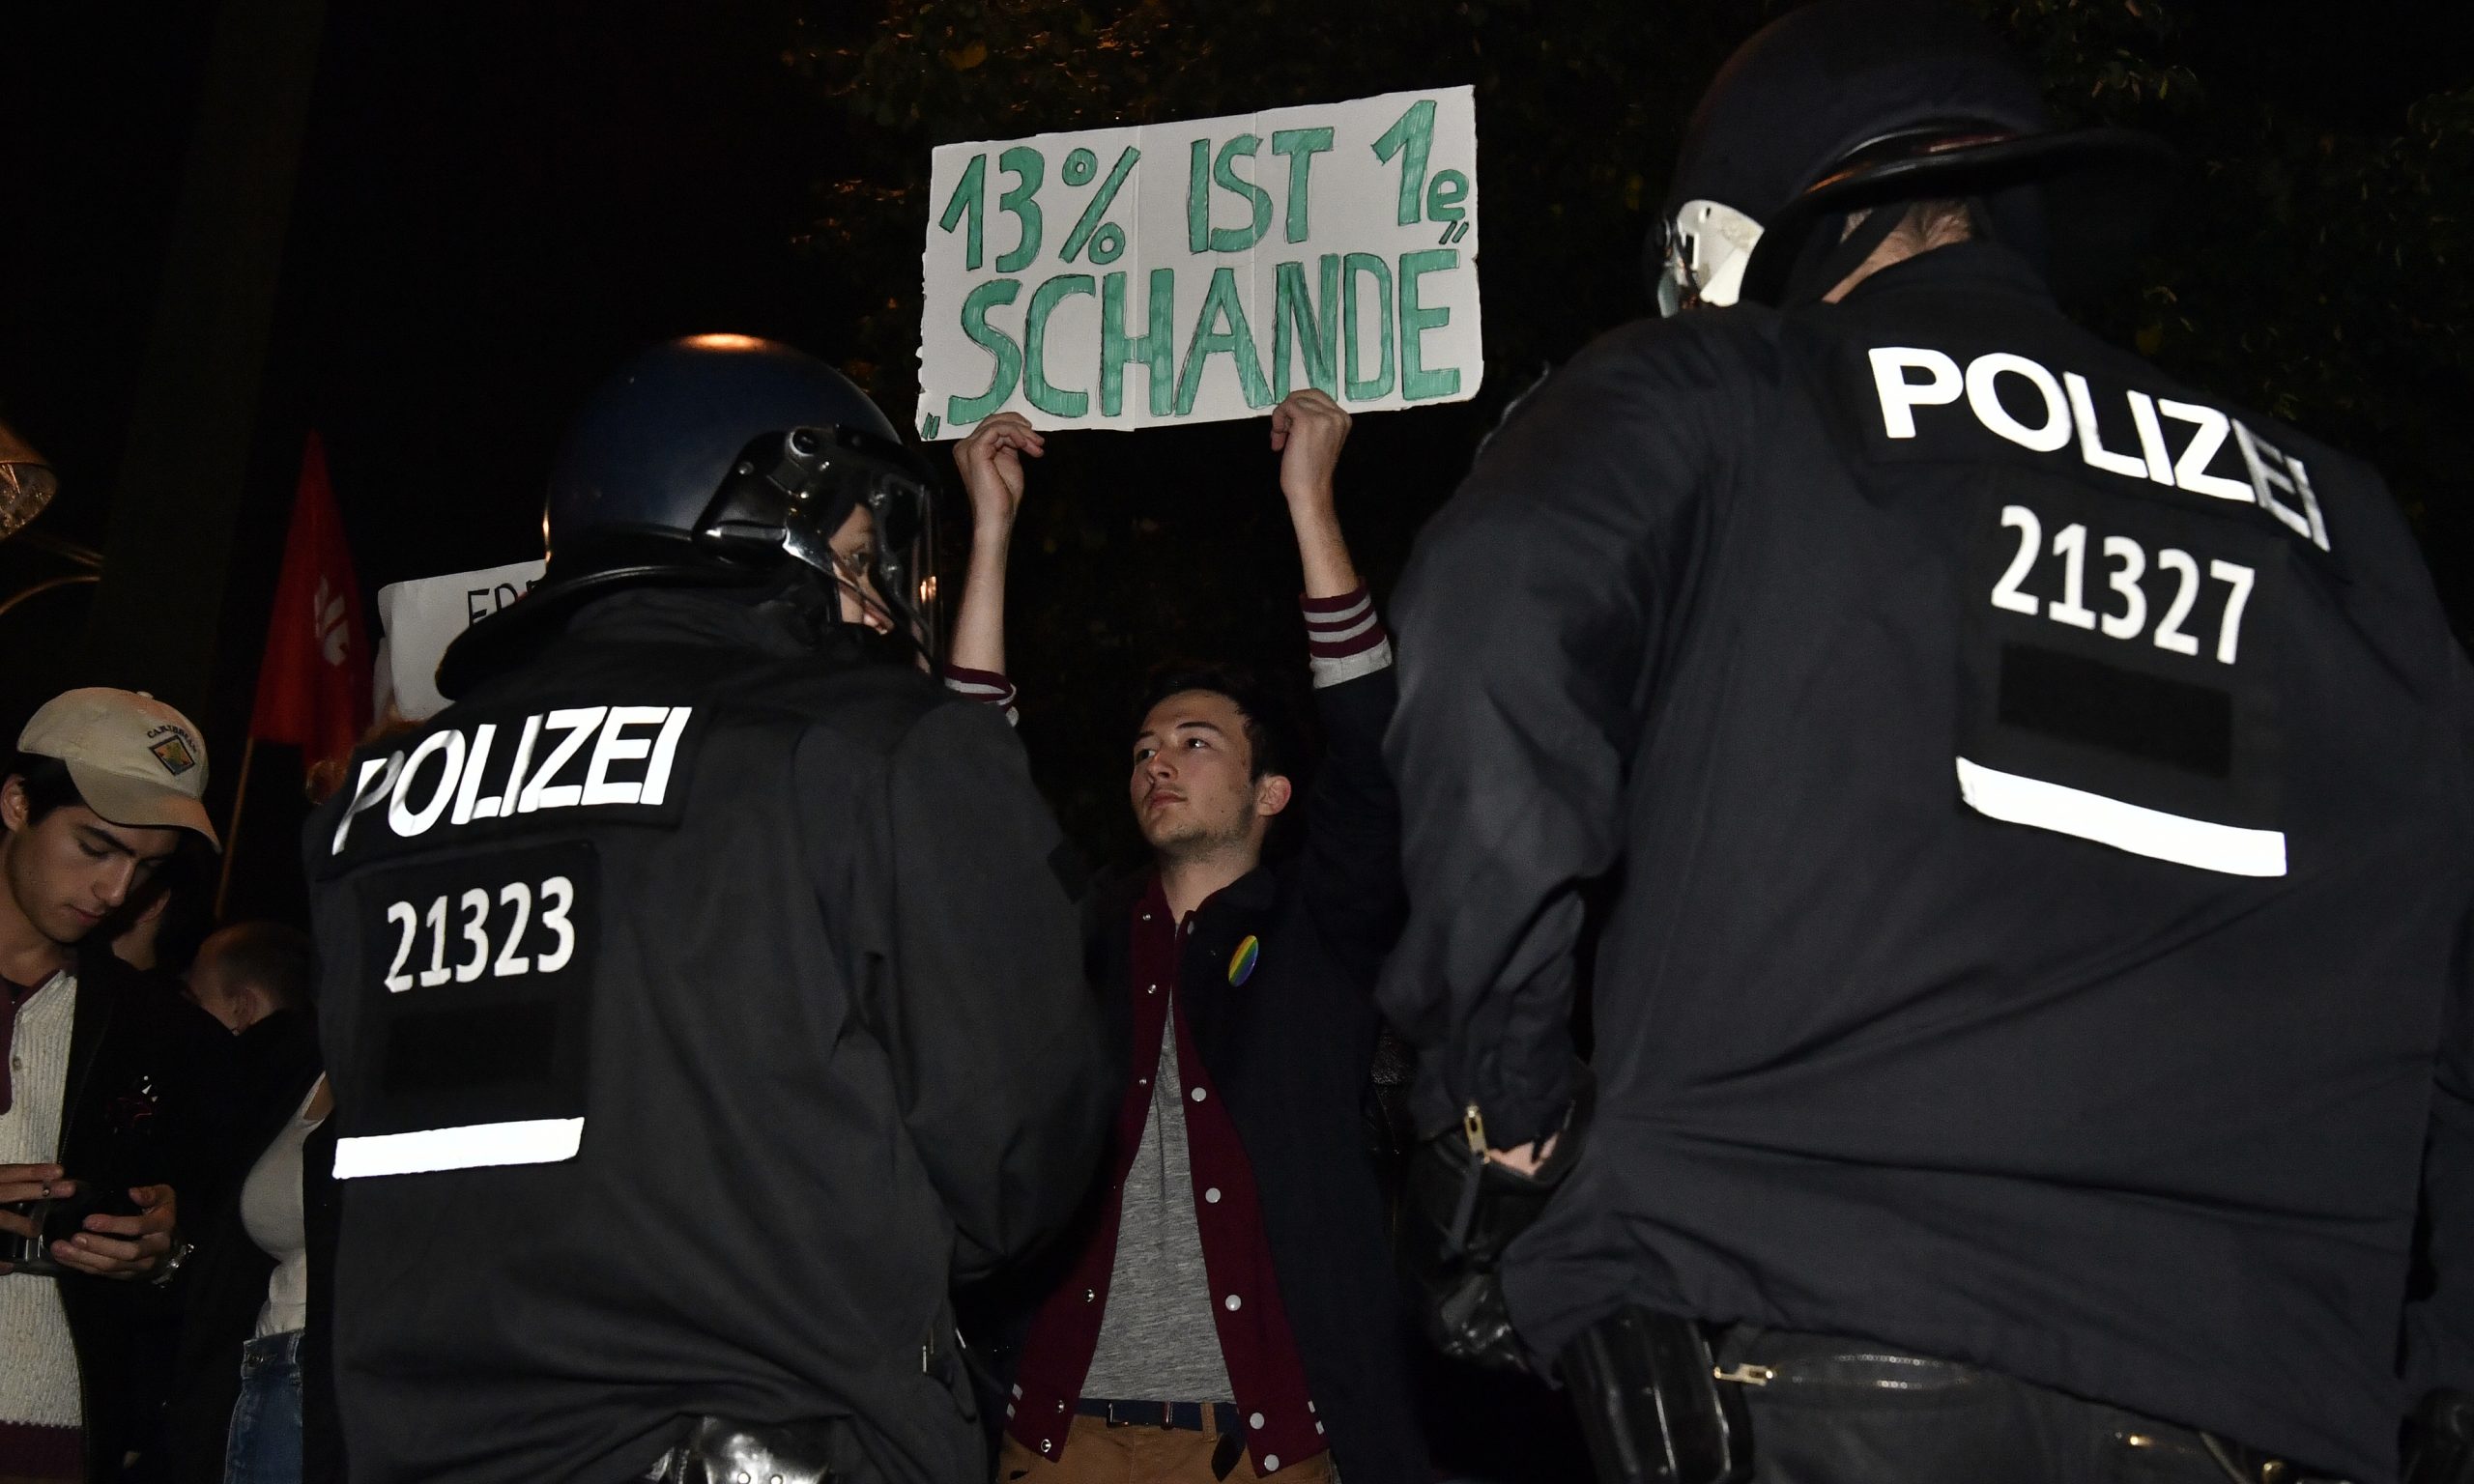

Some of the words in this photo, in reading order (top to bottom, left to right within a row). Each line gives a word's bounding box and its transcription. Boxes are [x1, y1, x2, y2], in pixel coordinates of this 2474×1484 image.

[939, 146, 1141, 273] 13%
[1188, 127, 1335, 253] IST
[1868, 346, 2331, 553] POLIZEI
[1991, 504, 2256, 665] 21327
[331, 705, 693, 856] POLIZEI
[384, 875, 576, 994] 21323
